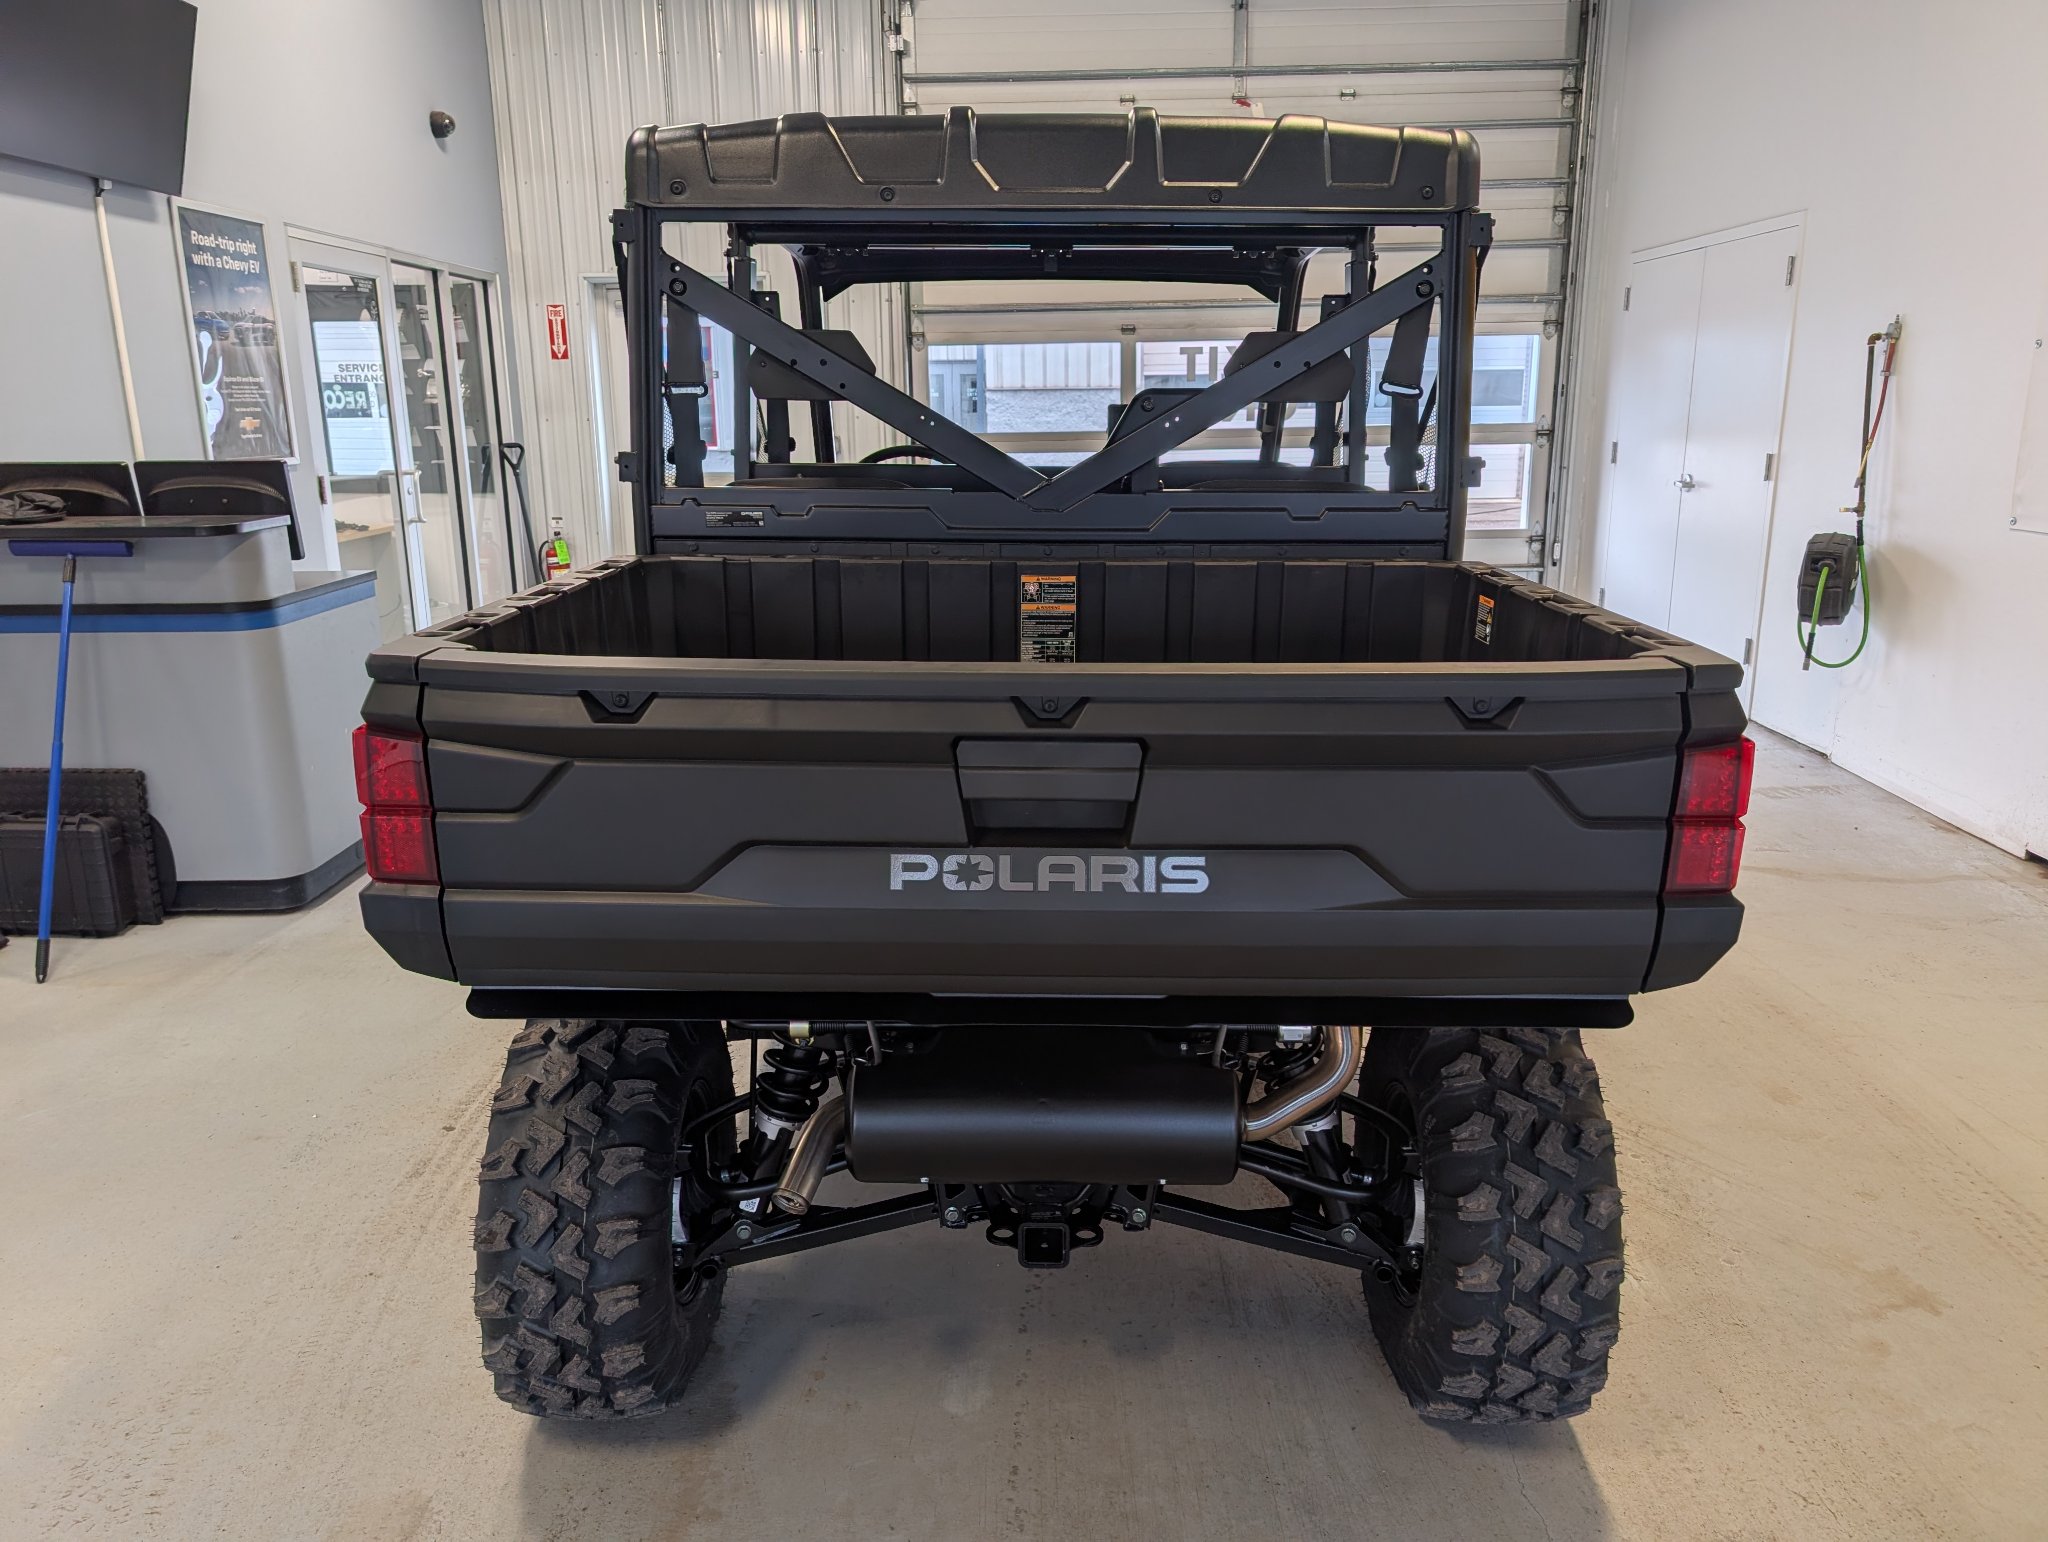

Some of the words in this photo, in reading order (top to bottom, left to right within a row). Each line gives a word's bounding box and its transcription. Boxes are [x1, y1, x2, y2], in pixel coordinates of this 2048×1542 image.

[190, 230, 235, 253] Road-trip
[236, 238, 257, 256] right
[192, 251, 215, 267] with
[216, 257, 222, 268] a
[222, 255, 249, 274] Chevy
[249, 260, 260, 274] EV
[334, 374, 385, 383] ENTRANC
[890, 854, 1210, 893] POLARIS
